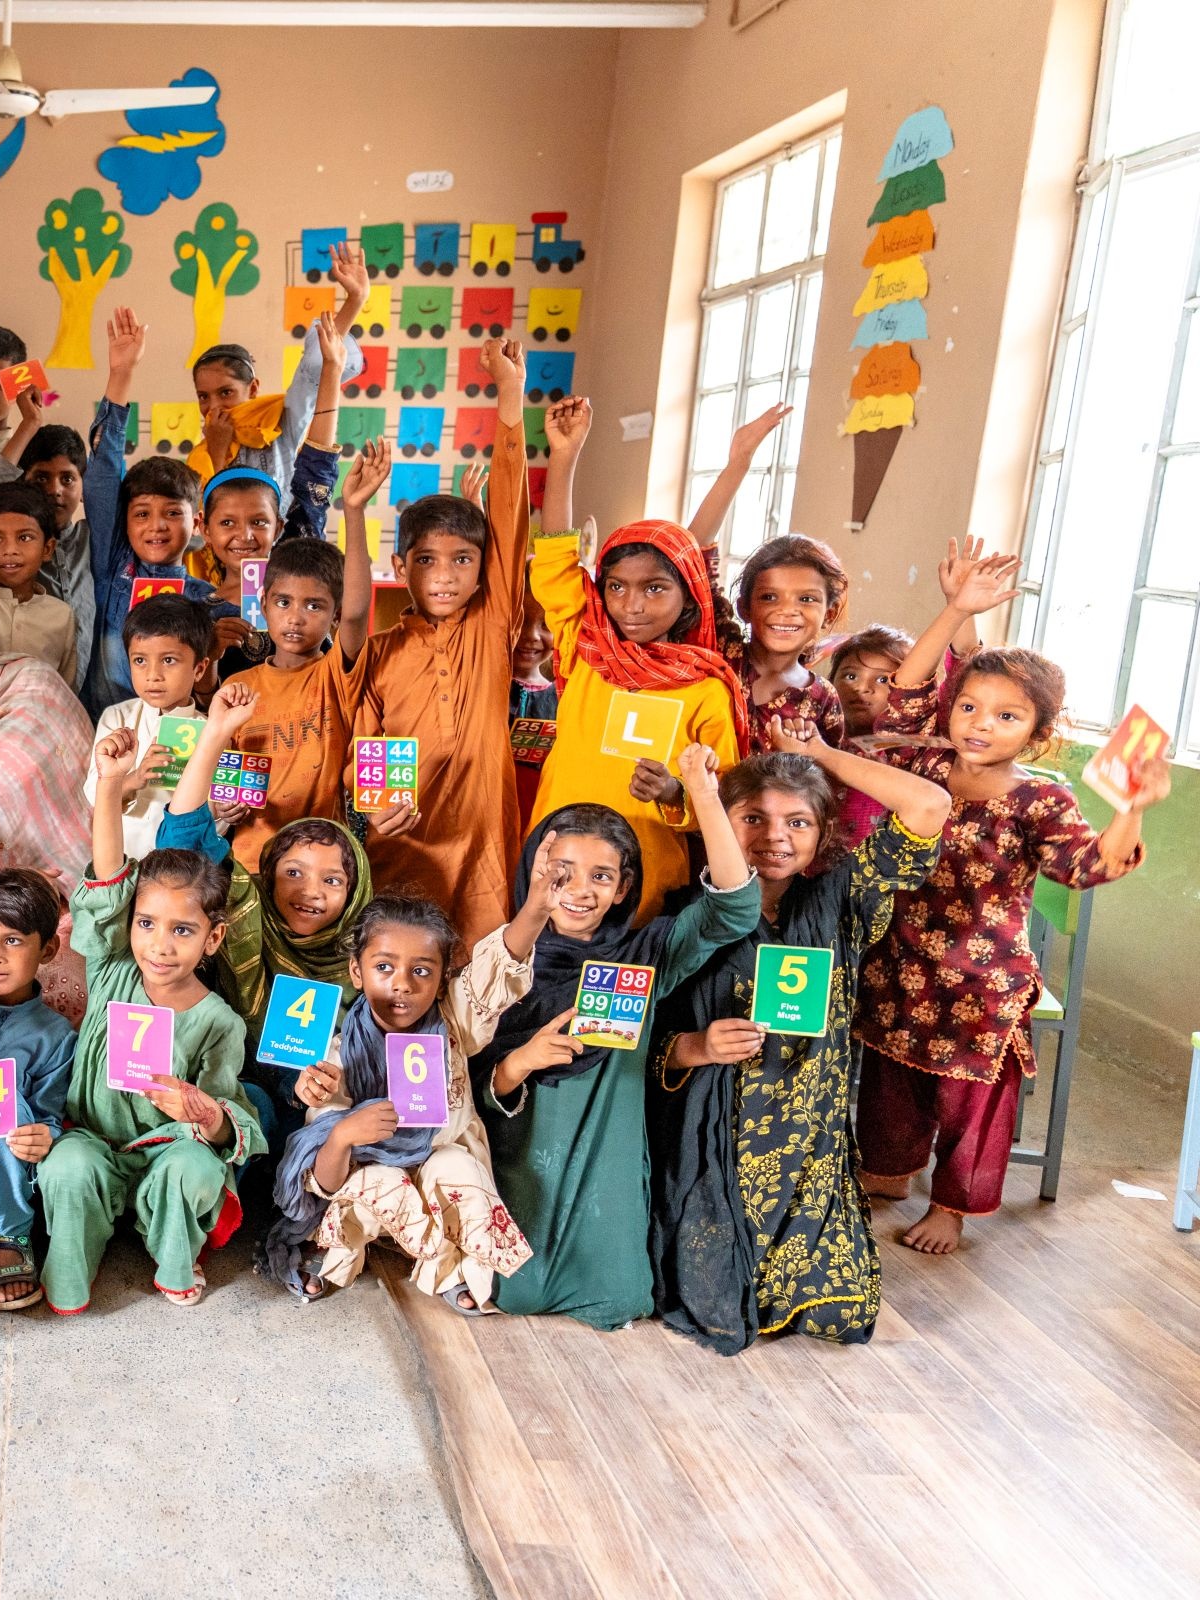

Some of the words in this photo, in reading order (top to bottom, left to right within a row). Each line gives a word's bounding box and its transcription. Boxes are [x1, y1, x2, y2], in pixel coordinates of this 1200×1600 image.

[11, 365, 32, 384] 2
[247, 602, 261, 626] t
[517, 721, 540, 732] 25
[622, 711, 654, 745] L
[172, 724, 197, 758] 3
[512, 735, 535, 744] 27
[359, 742, 383, 757] 43
[389, 742, 414, 758] 44
[218, 753, 240, 765] 55
[246, 757, 269, 769] 56
[215, 769, 238, 781] 57
[244, 773, 266, 785] 58
[359, 766, 383, 782] 45
[389, 767, 413, 783] 46
[213, 785, 236, 798] 59
[241, 789, 264, 802] 60
[359, 790, 383, 805] 47
[388, 791, 413, 804] 48
[587, 967, 615, 985] 97
[621, 970, 648, 988] 98
[776, 955, 808, 995] 5
[286, 988, 317, 1028] 4
[581, 993, 609, 1012] 99
[613, 997, 645, 1013] 100
[780, 1003, 800, 1012] Five
[777, 1011, 801, 1022] Mugs
[127, 1012, 155, 1052] 7
[285, 1034, 305, 1045] Four
[270, 1040, 316, 1057] Teddybears
[127, 1060, 151, 1071] Seven
[403, 1043, 428, 1085] 6
[126, 1069, 150, 1080] Chair
[409, 1103, 427, 1112] Bags
